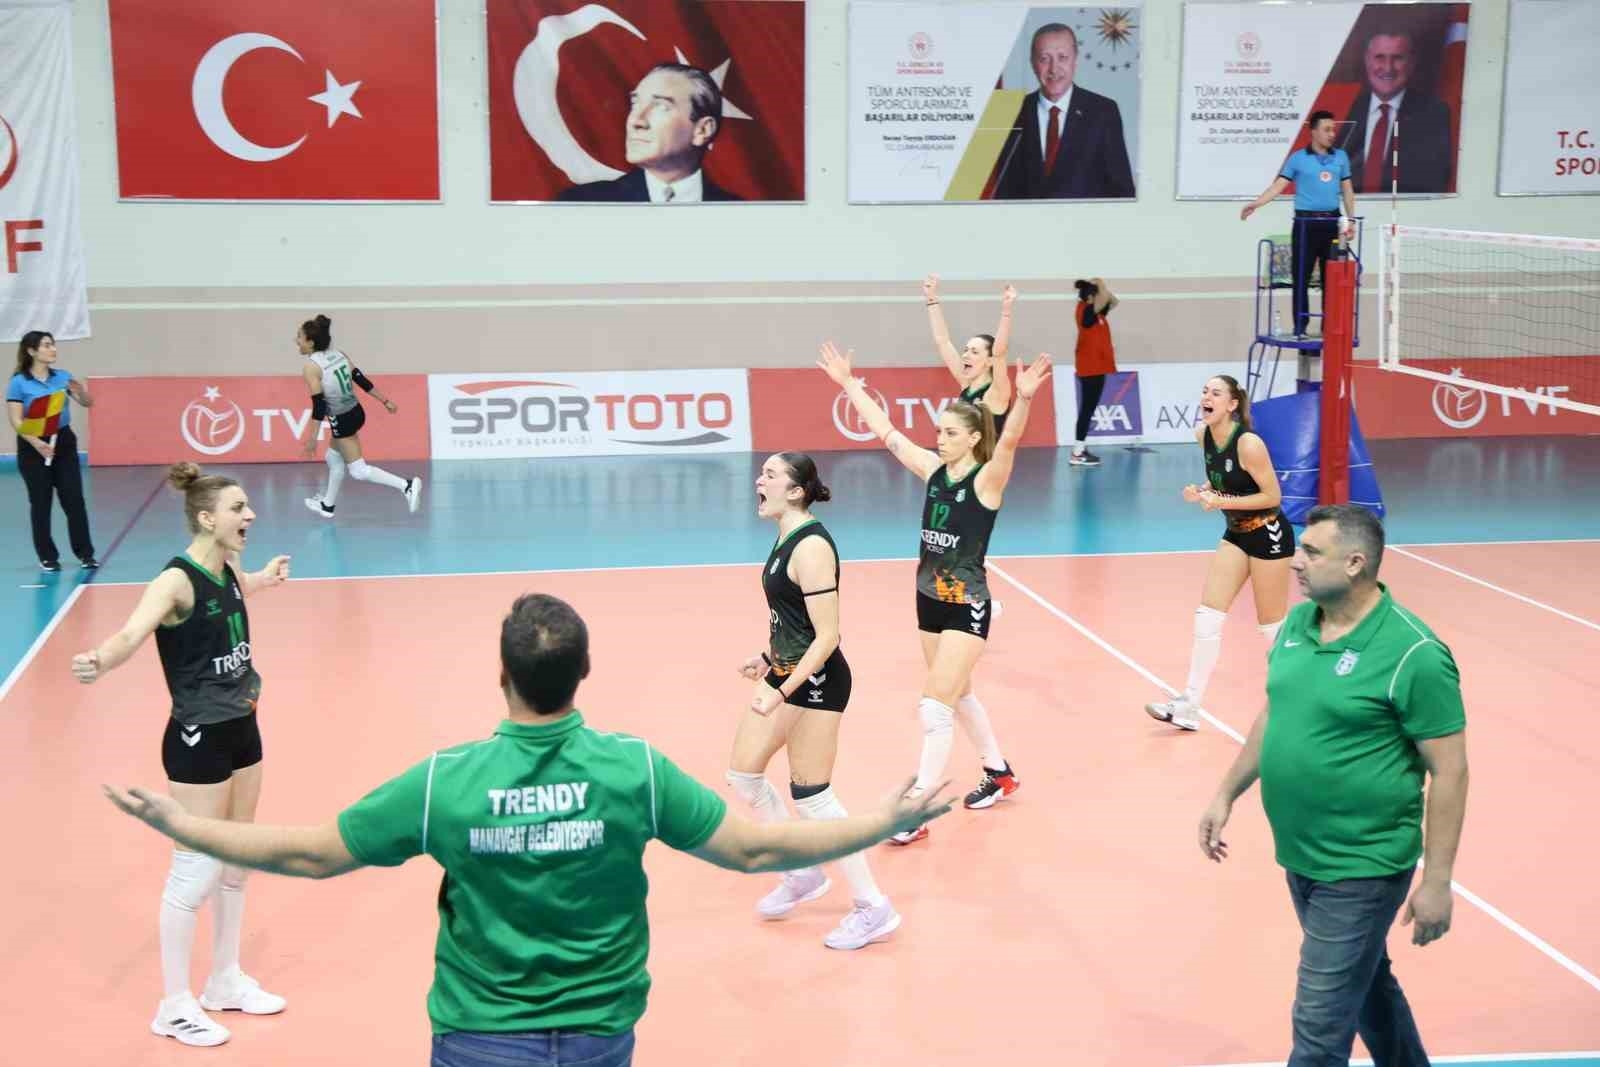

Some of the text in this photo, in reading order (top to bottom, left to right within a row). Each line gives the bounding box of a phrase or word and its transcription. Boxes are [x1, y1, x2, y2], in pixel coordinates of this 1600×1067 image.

[867, 84, 974, 97] TÜM ANTRENÖR VE
[1193, 84, 1299, 97] TÜM ANTRENÖR VE
[871, 98, 969, 110] SPORCULARIMIZA
[865, 112, 919, 124] BAŞARILAR
[1191, 112, 1244, 122] BAŞARILAR
[1557, 130, 1595, 149] T.C.
[1555, 157, 1600, 176] SPO
[334, 364, 352, 395] 15
[896, 397, 960, 428] TV
[930, 503, 950, 529] 12
[487, 782, 589, 816] TRENDY
[470, 825, 527, 854] MANAVGAT
